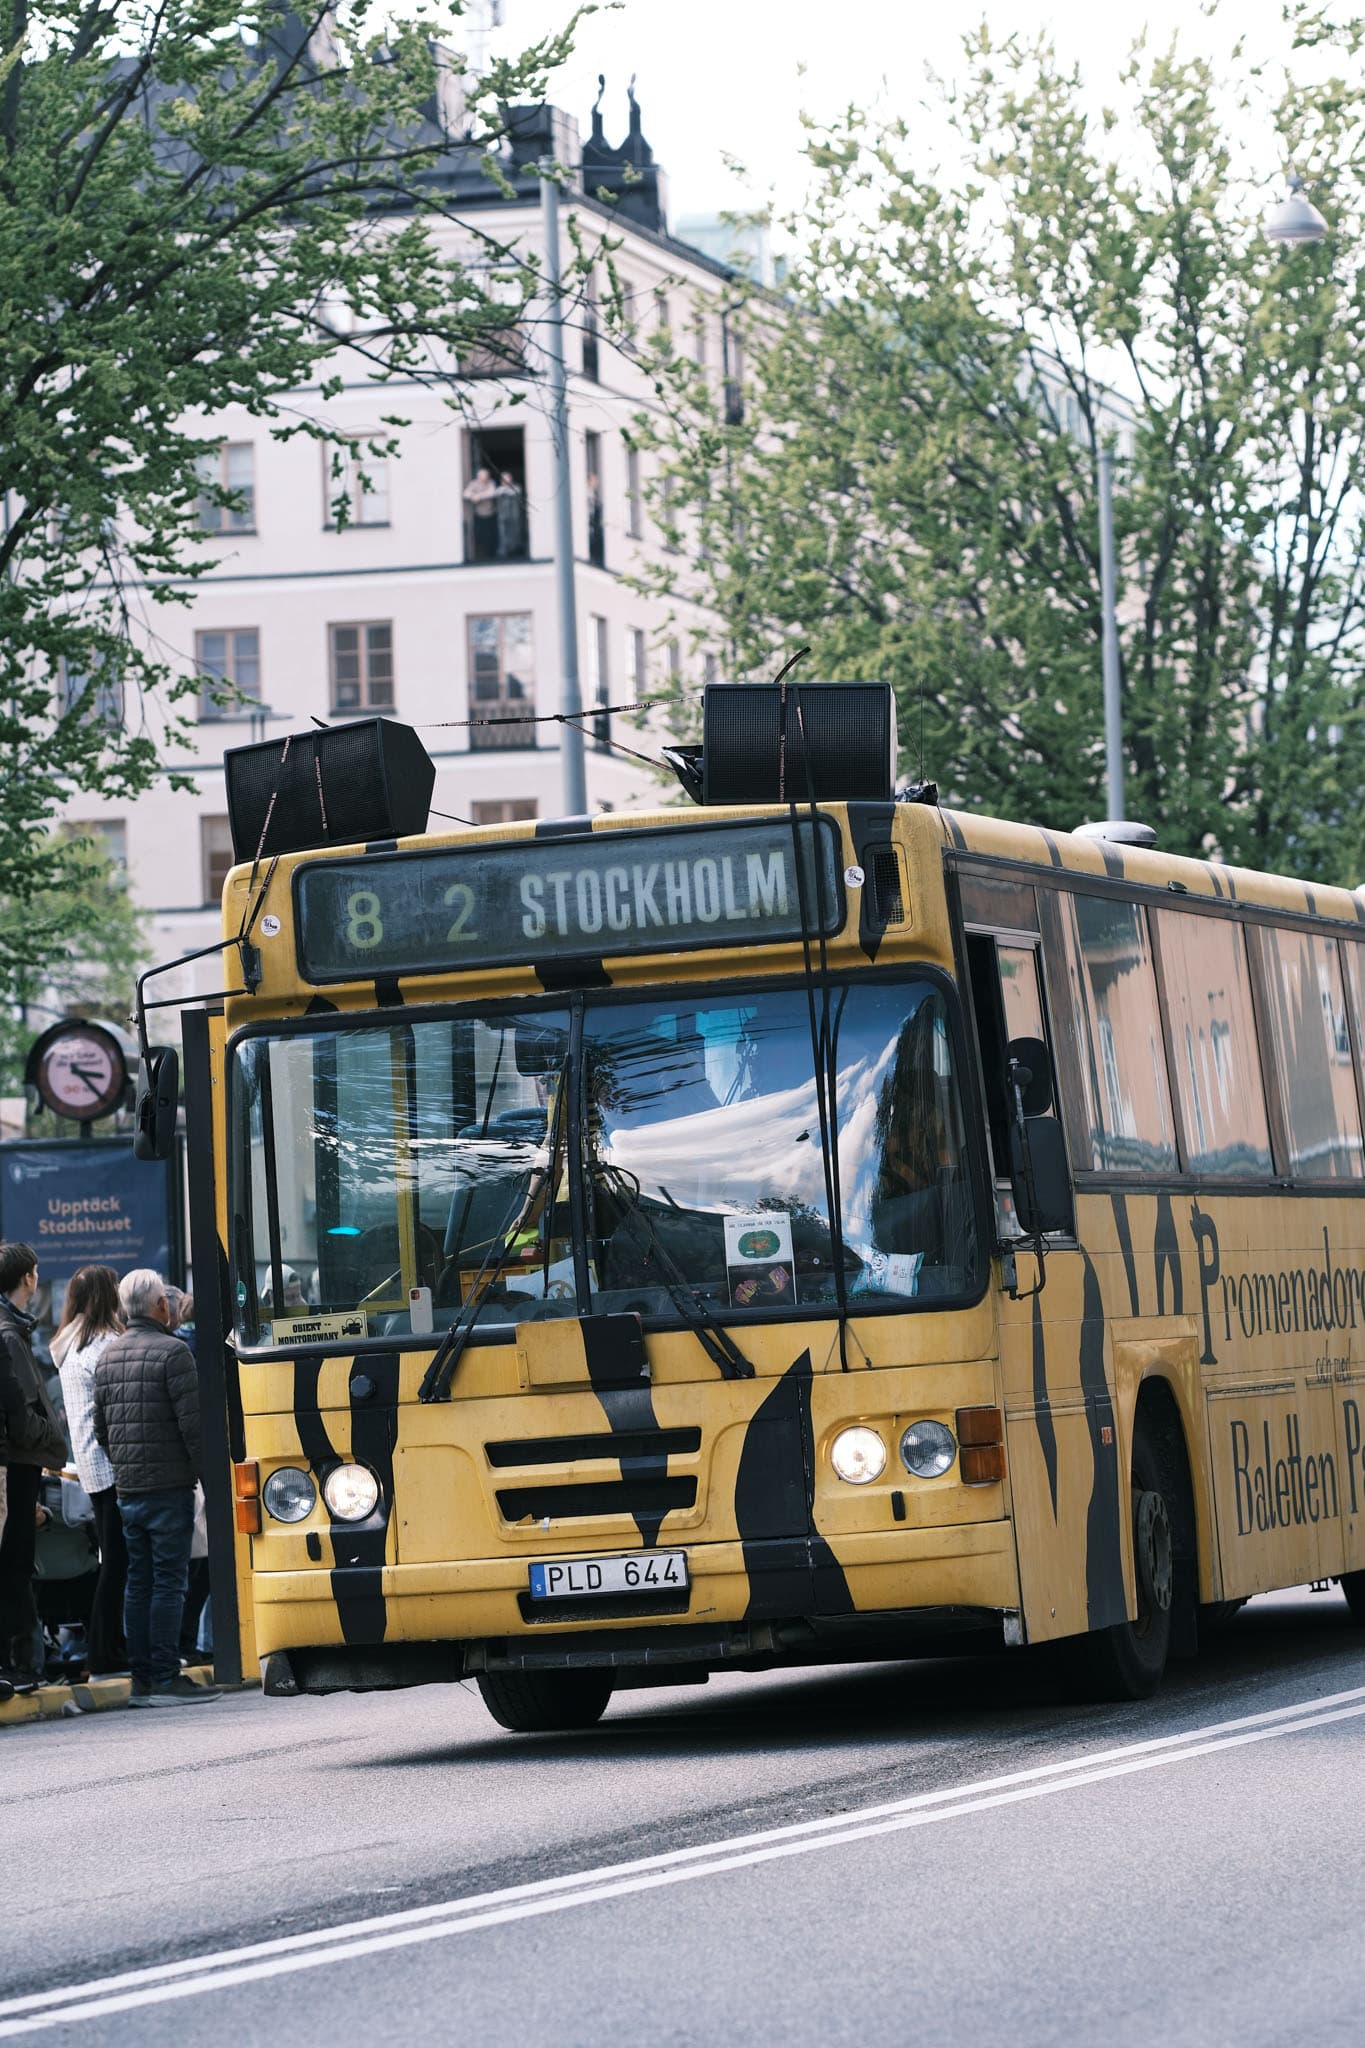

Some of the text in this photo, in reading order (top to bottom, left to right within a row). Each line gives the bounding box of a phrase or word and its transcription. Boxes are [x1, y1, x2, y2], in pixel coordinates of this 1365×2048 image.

[345, 849, 790, 949] 8 2 STOCKHOLM
[38, 1216, 132, 1235] Stadshuset
[1189, 1191, 1365, 1365] Promenador
[278, 1332, 339, 1345] MONITOROWANY
[292, 1322, 322, 1333] OBIEKT
[1230, 1412, 1340, 1536] Baletten
[548, 1558, 679, 1592] PLD 644
